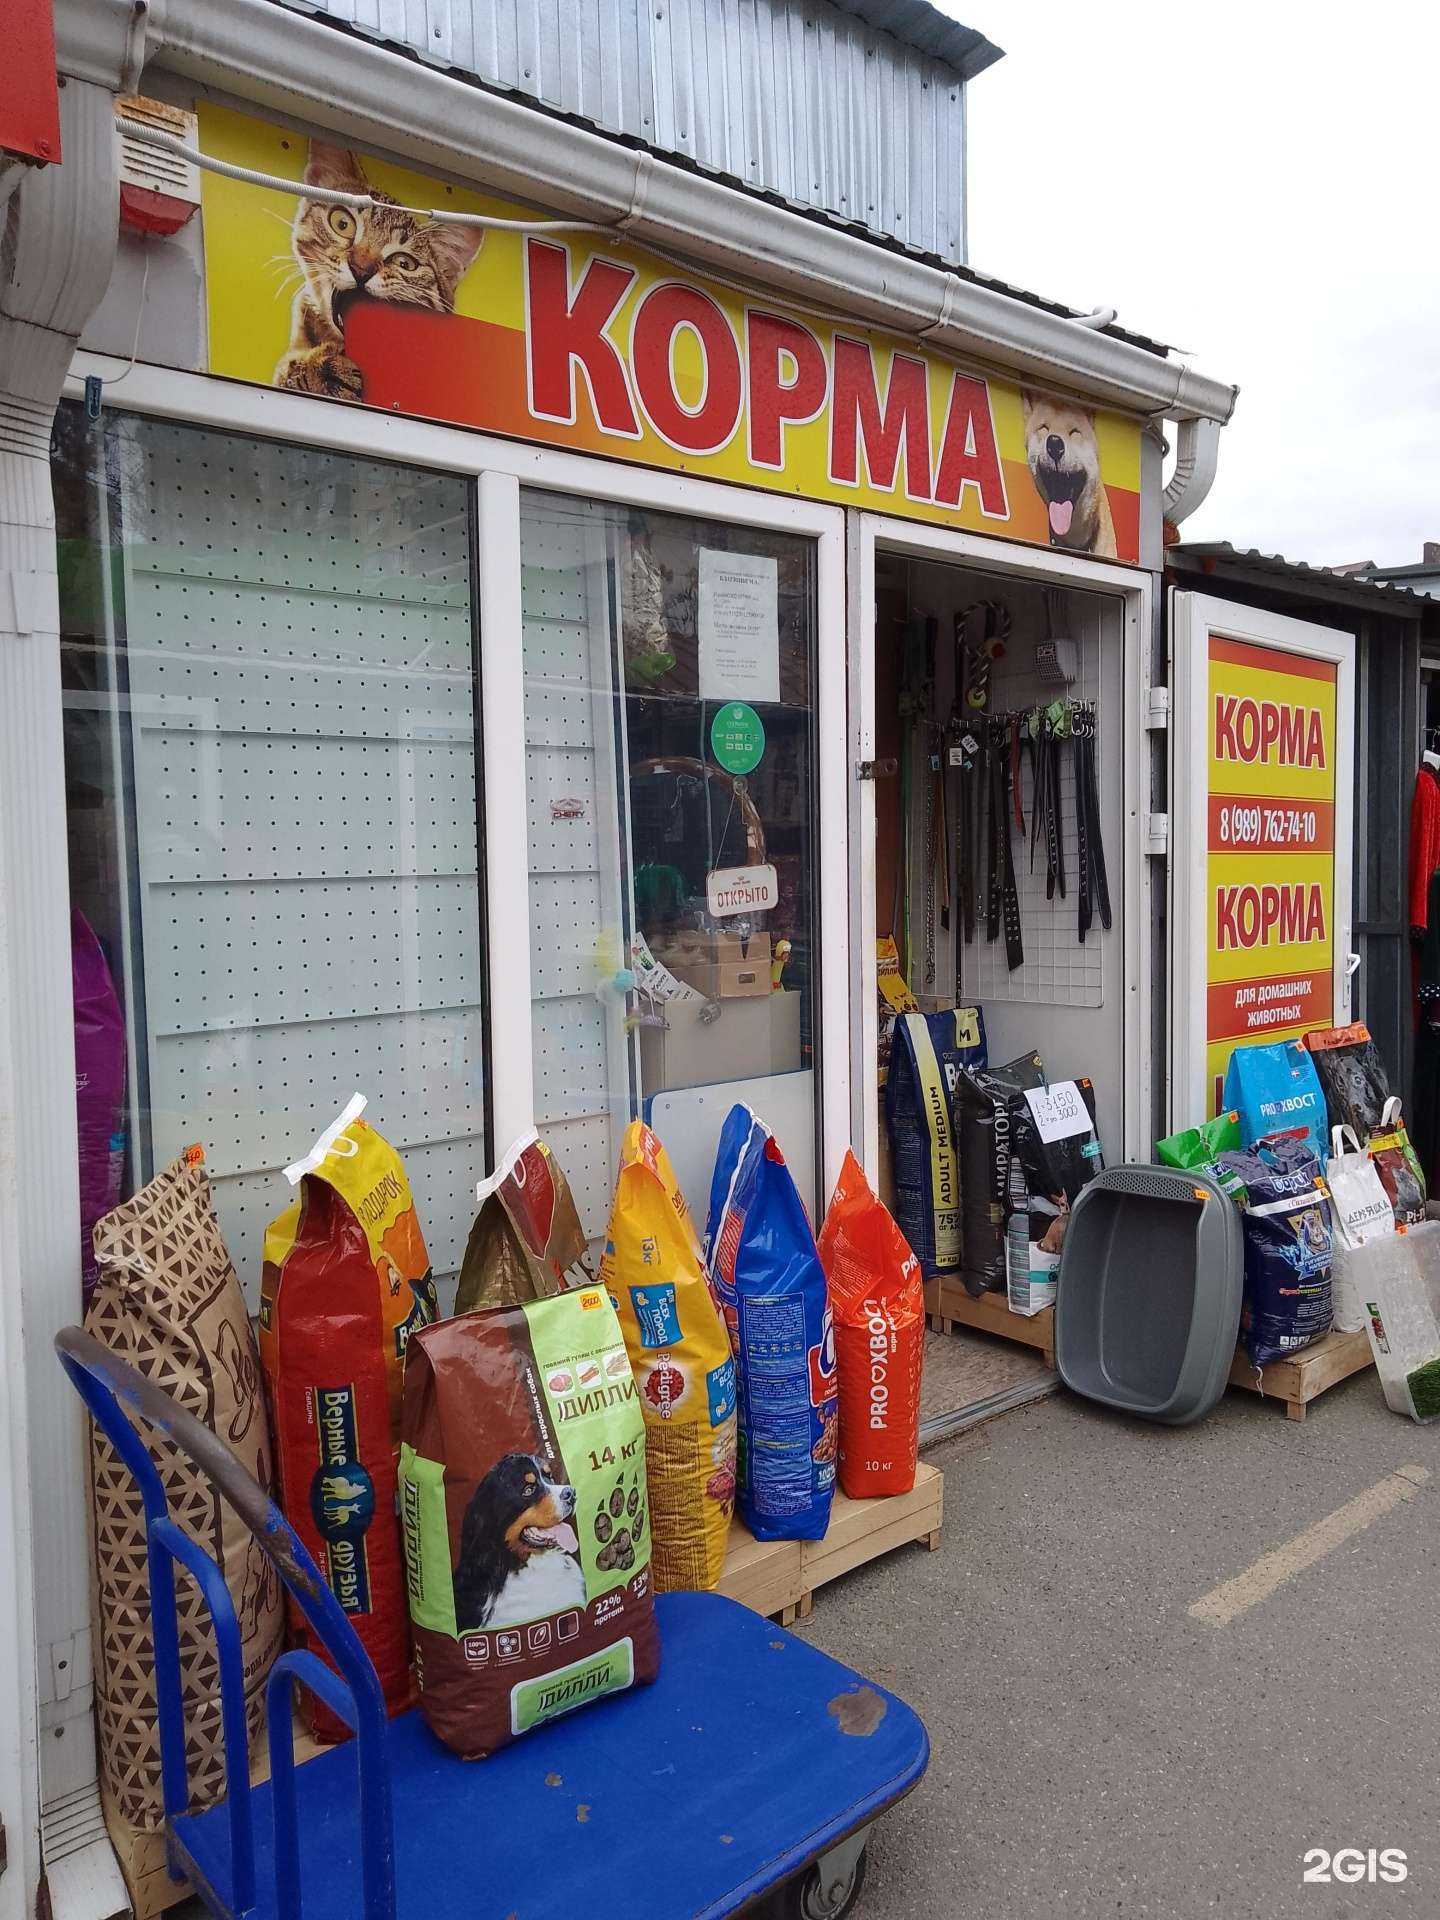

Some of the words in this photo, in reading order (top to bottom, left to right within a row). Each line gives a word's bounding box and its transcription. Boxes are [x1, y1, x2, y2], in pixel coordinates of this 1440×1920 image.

[524, 232, 1010, 521] КОРМА
[1215, 693, 1327, 770] КОРМА
[1220, 808, 1229, 842] 8
[1232, 804, 1261, 845] (989)
[1264, 810, 1316, 842] 762-74-10
[717, 886, 769, 908] ОТКРЫТО
[1216, 882, 1327, 952] КОРМА
[1235, 987, 1256, 1008] для
[1258, 980, 1312, 1005] домашних
[1247, 1005, 1302, 1027] животных
[959, 1029, 972, 1042] M
[929, 1086, 949, 1148] MEDIUM
[939, 1152, 952, 1204] ADULT
[658, 1297, 671, 1321] ВСЕХ
[651, 1309, 668, 1345] ПОРОД
[525, 1367, 537, 1395] собак
[656, 1352, 673, 1420] Pedigree
[321, 1391, 349, 1466] Верные
[533, 1395, 549, 1440] взрослых
[544, 1441, 556, 1459] для
[588, 1446, 615, 1471] 14
[620, 1440, 638, 1460] кг
[865, 1461, 879, 1471] 10
[882, 1462, 893, 1471] кг
[331, 1540, 359, 1608] друзья
[593, 1605, 625, 1628] протеин
[595, 1593, 622, 1616] 22%
